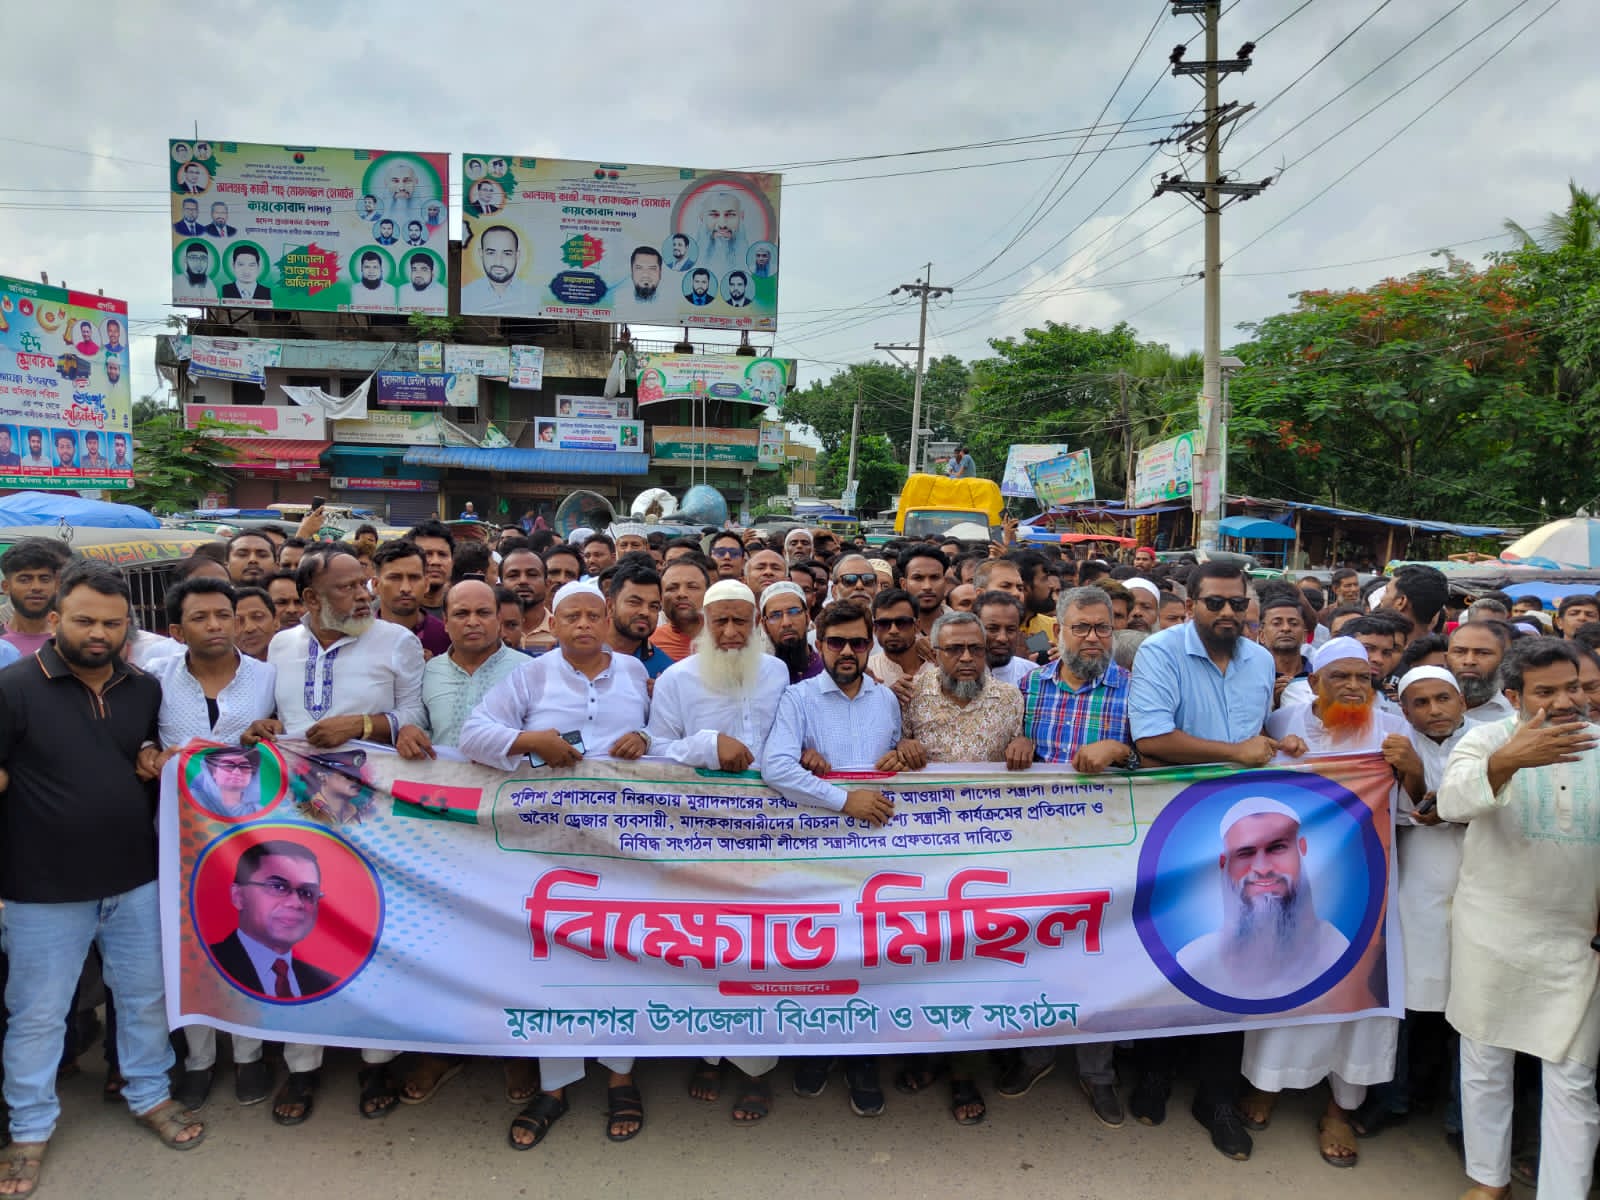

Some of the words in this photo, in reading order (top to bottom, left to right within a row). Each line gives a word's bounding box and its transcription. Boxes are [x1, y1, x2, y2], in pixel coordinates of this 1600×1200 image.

[248, 200, 306, 214] কায়কোবাদ
[561, 206, 614, 217] কায়কোবাদ
[322, 267, 330, 277] ও
[285, 276, 331, 289] অভিনন্দন
[16, 352, 56, 371] মোবারক
[510, 787, 548, 807] পুলিশ
[551, 789, 617, 806] প্রশাসনের
[620, 787, 682, 807] নিরবতায়
[686, 794, 763, 811] মুরাদনগরের
[900, 788, 955, 804] আওয়ামী
[518, 809, 560, 825] অবৈধ
[564, 814, 609, 829] ড্রেজার
[612, 810, 675, 831] ব্যবসায়ী,
[680, 813, 794, 831] মাদককারবারীদের
[799, 813, 840, 830] বিচরন
[844, 814, 856, 828] ও
[912, 807, 952, 825] সন্ত্রাসী
[955, 804, 1023, 823] কার্যক্রমের
[1027, 800, 1087, 820] প্রতিবাদে
[1091, 801, 1104, 814] ও
[619, 832, 661, 852] নিষিদ্ধ
[665, 831, 713, 852] সংগঠন
[716, 833, 774, 851] আওয়ামী
[777, 833, 818, 850] লীগের
[822, 830, 887, 850] সন্ত্রাসীদের
[892, 831, 961, 849] গ্রেফতারের
[964, 826, 1013, 845] দাবিতে
[526, 868, 841, 971] বিক্ষোভ
[858, 869, 1111, 968] মিছিল
[503, 1005, 638, 1041] মুরাদনগর
[645, 1000, 767, 1034] উপজেলা
[773, 998, 881, 1034] বিএনপি
[889, 1006, 913, 1029] ও
[919, 1004, 975, 1031] অঙ্গ
[980, 993, 1081, 1032] সংগঠন
